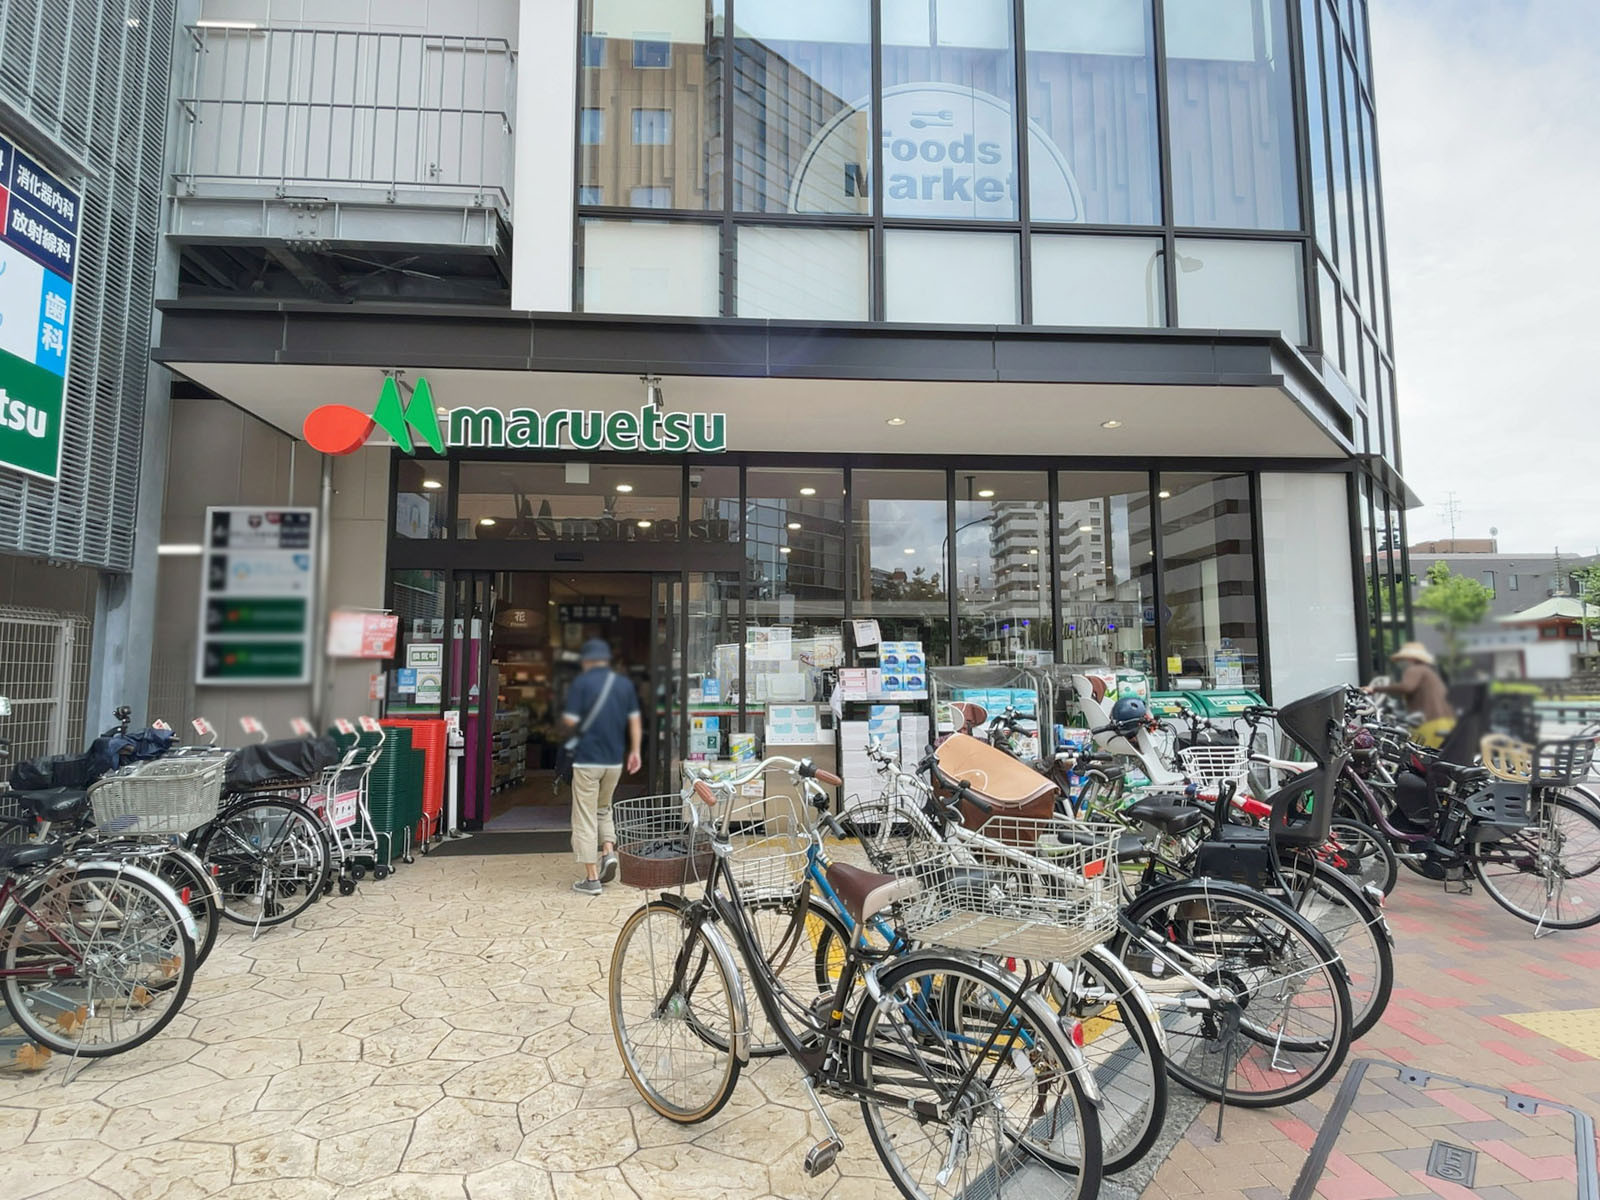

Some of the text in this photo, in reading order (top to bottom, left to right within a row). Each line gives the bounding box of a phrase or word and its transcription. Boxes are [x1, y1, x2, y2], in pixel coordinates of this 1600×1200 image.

[17, 164, 74, 222] 消化器内科
[11, 208, 71, 263] 放射線科
[41, 291, 67, 357] 歯科
[448, 403, 727, 452] maruetsu
